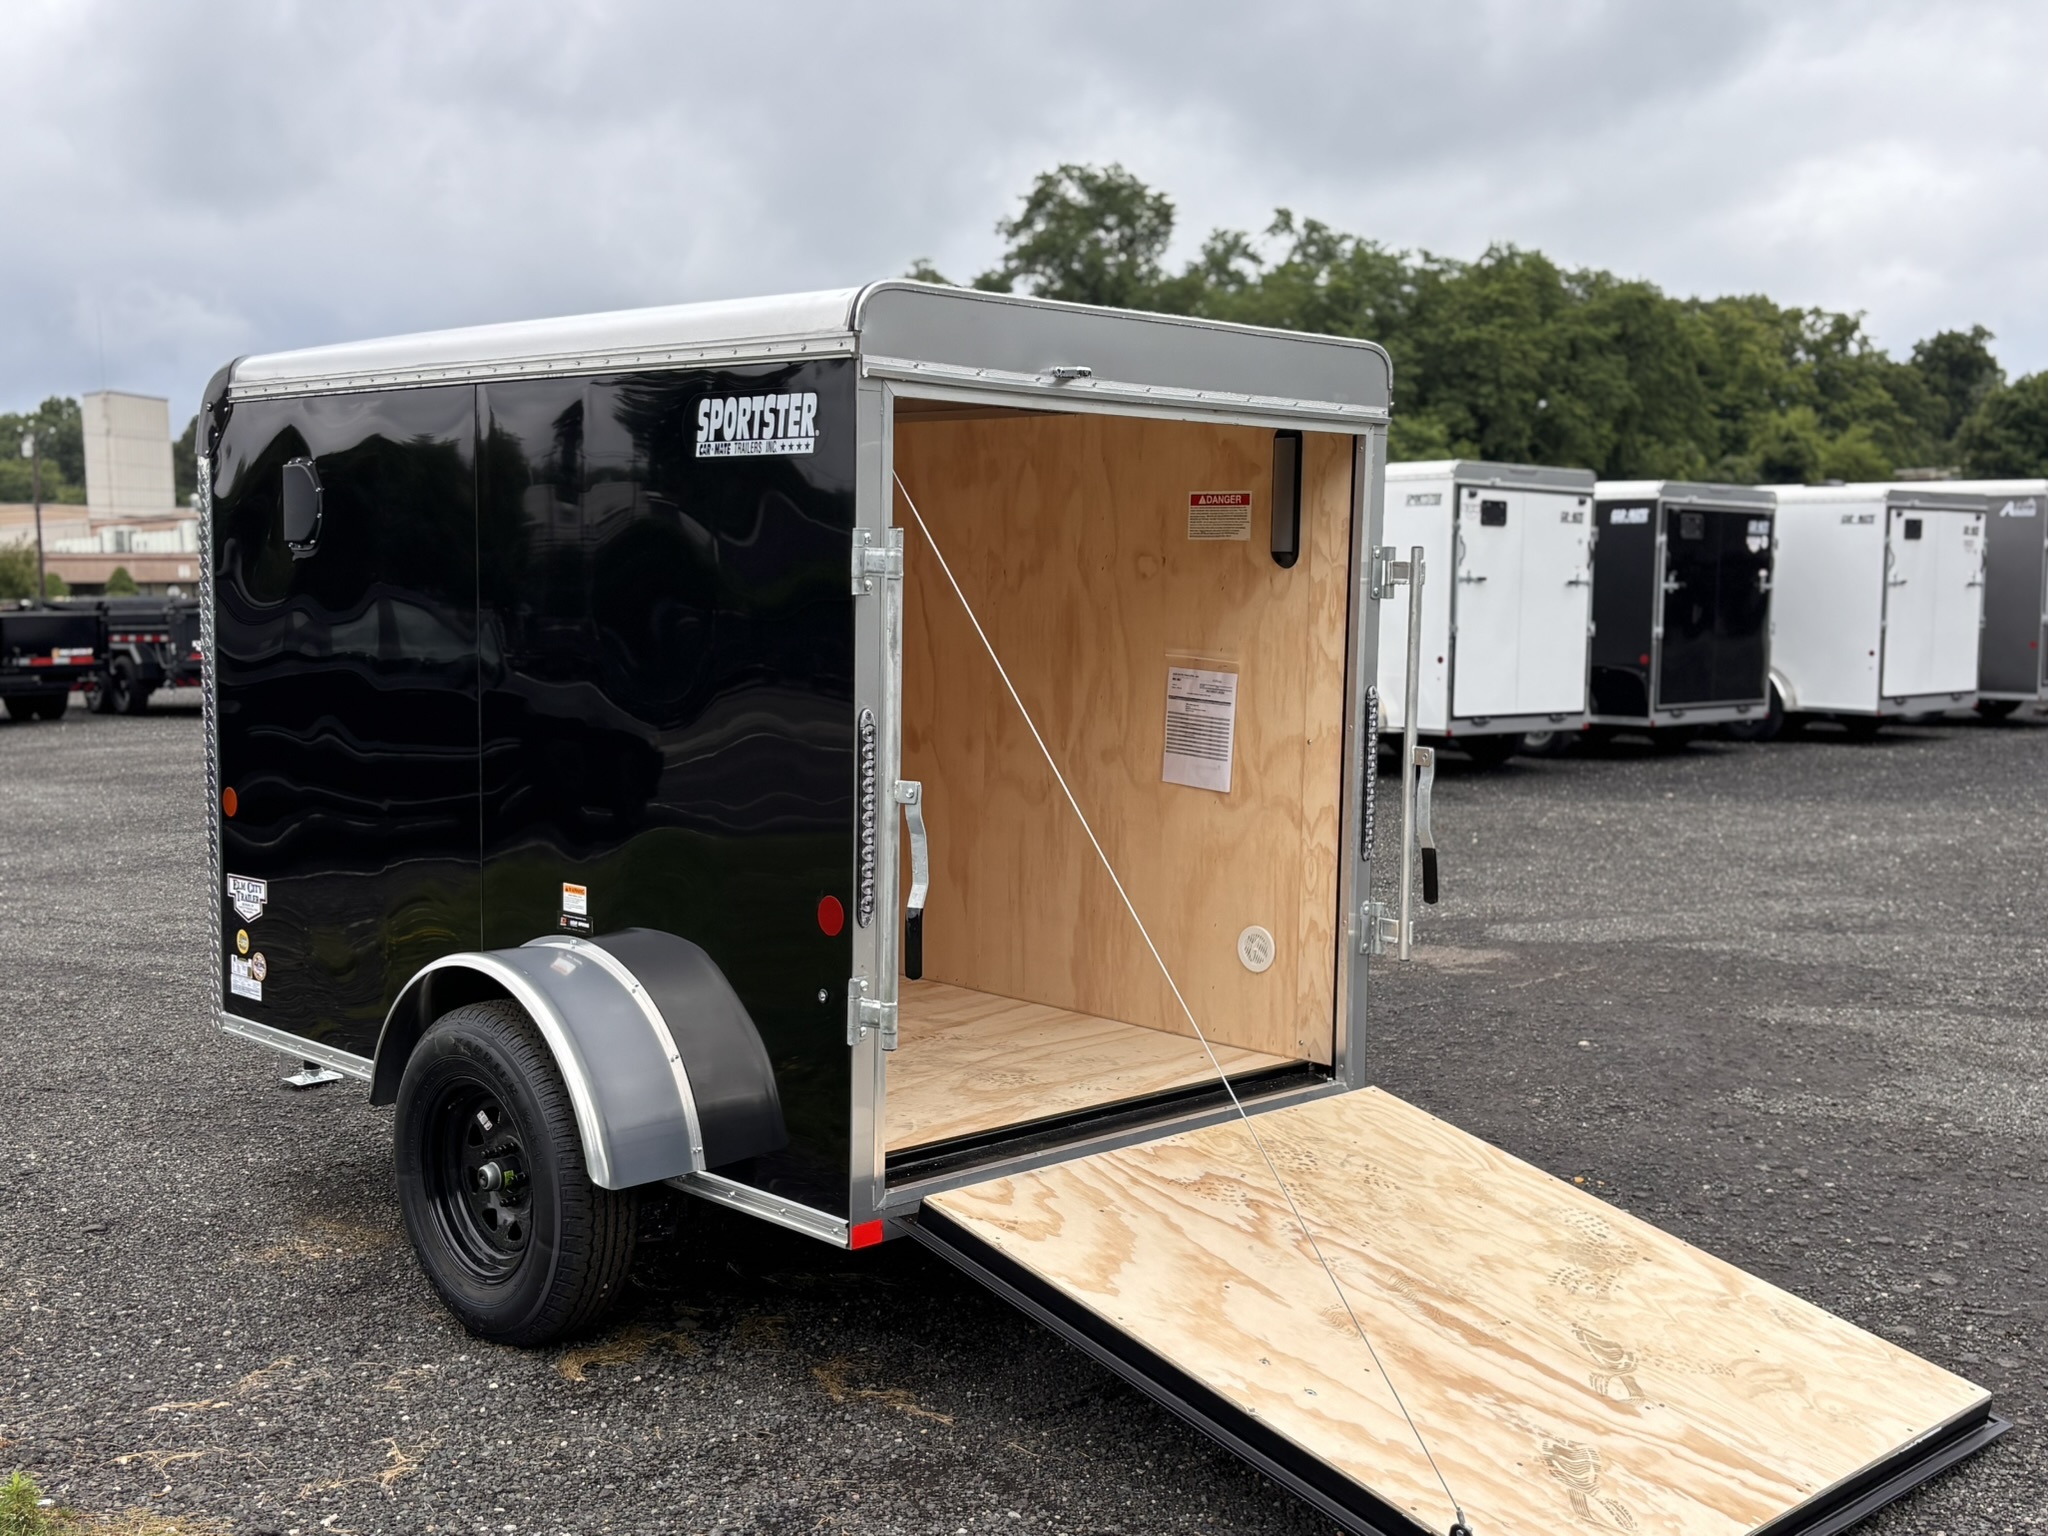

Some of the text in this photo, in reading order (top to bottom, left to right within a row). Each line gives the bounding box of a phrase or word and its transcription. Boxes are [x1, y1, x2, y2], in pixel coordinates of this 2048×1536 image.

[697, 392, 818, 442] SPORTSTER
[734, 442, 762, 454] TRAILERS
[1206, 495, 1242, 504] DANGER
